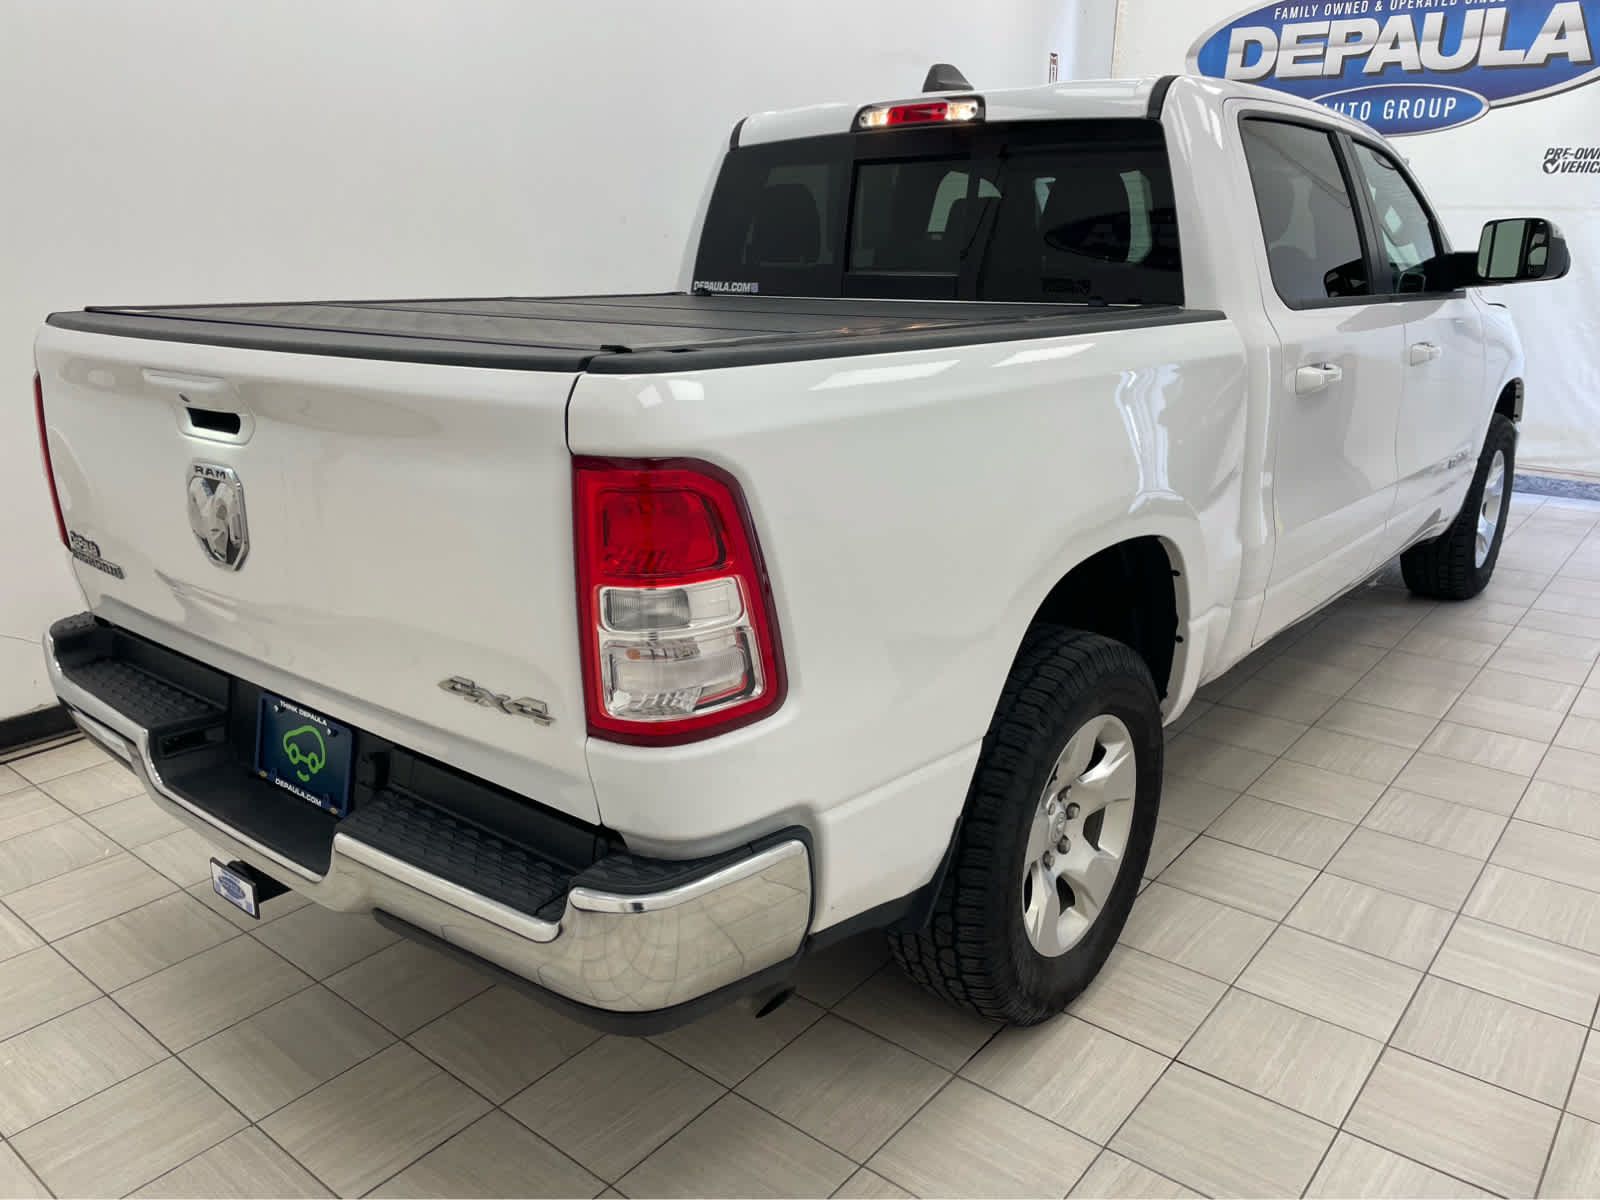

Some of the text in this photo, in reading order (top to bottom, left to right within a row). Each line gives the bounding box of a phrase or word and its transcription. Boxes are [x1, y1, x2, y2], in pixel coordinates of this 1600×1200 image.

[1274, 4, 1319, 20] FAMILY
[1324, 0, 1369, 16] OWNED
[1374, 0, 1383, 12] &
[1224, 1, 1592, 81] DEPAULA
[1323, 97, 1457, 121] UTO GROUP
[194, 465, 226, 480] RAM
[280, 699, 328, 726] THINK DEPAULA
[275, 778, 322, 808] DEPAULA.COM
